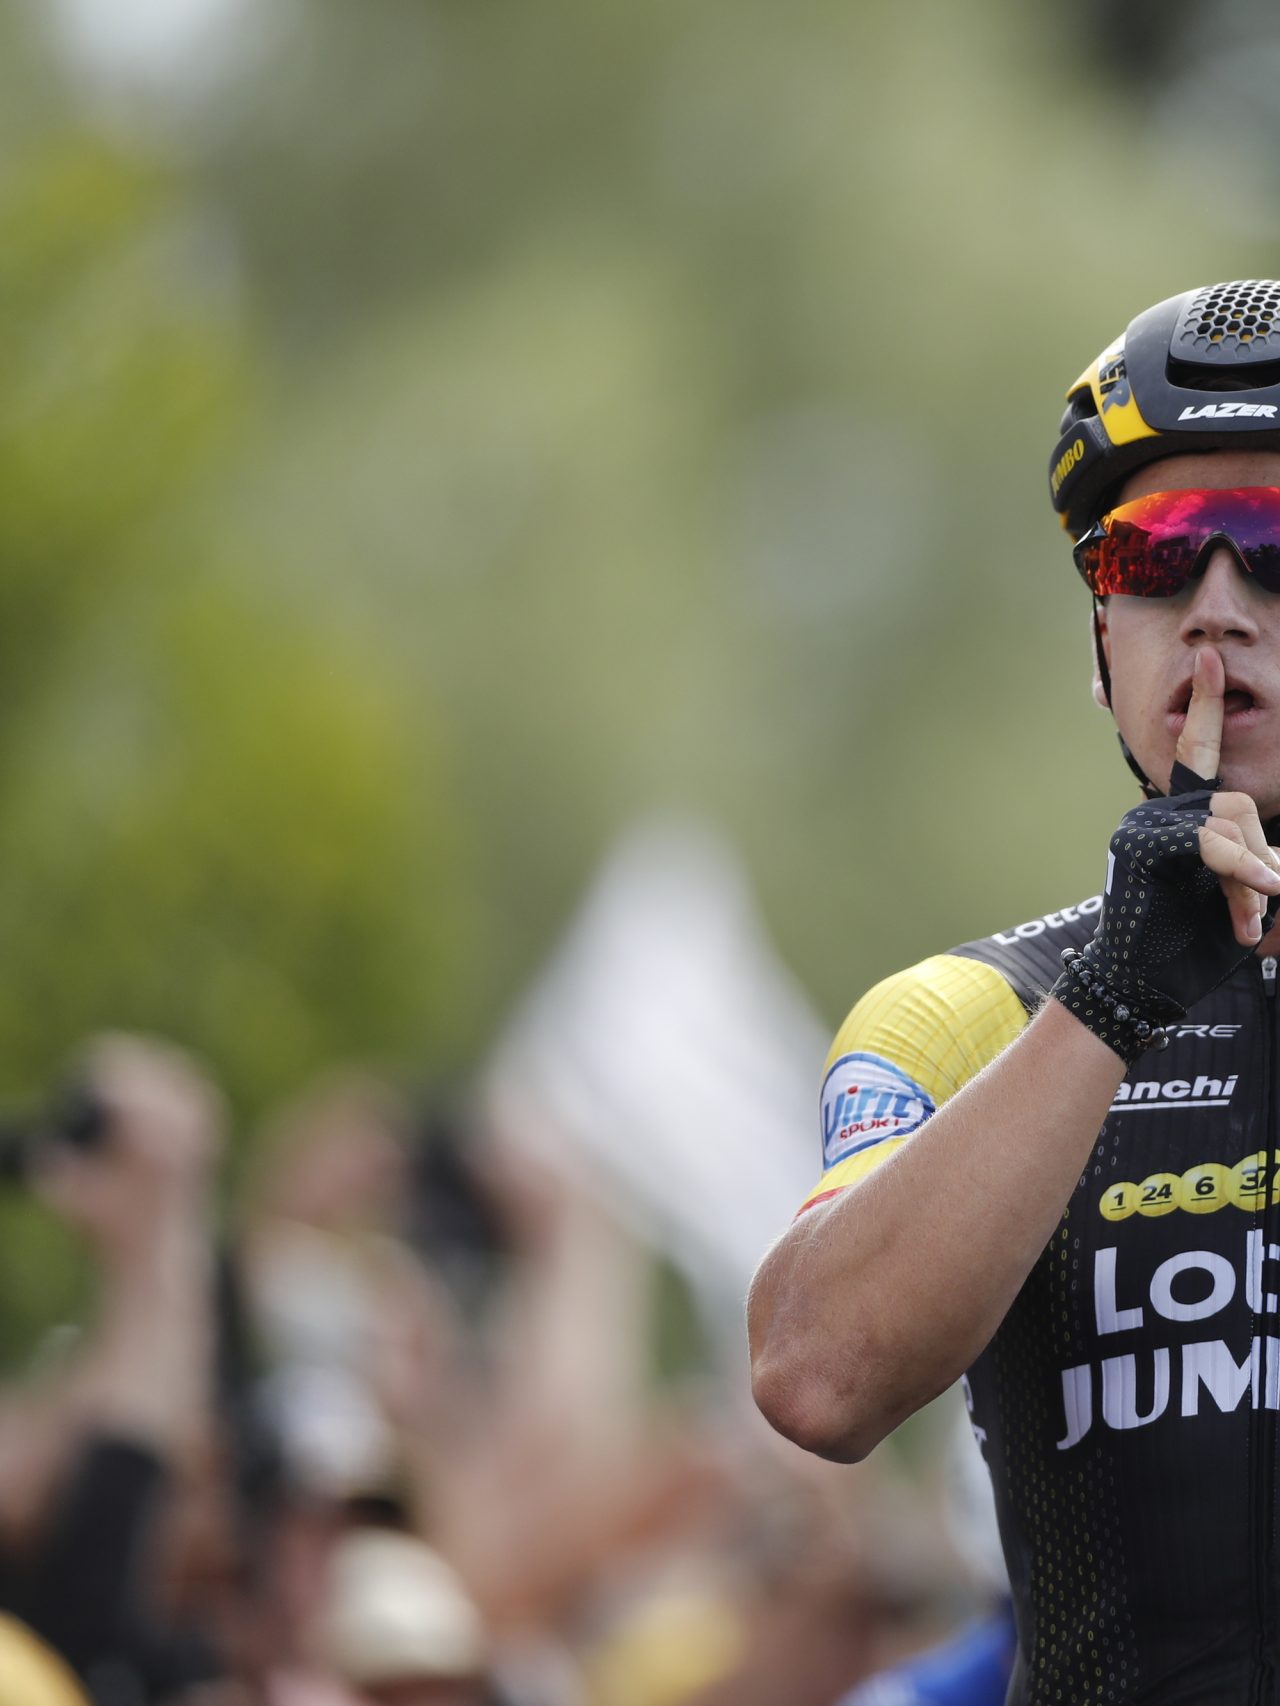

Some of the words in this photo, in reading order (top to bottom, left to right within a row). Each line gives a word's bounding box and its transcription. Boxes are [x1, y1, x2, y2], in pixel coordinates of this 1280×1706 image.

[1178, 403, 1279, 421] LAZER
[991, 895, 1104, 946] Lotto
[1113, 1074, 1240, 1102] anchi
[1113, 1192, 1125, 1207] 1
[1141, 1183, 1173, 1201] 24
[1195, 1176, 1215, 1195] 6
